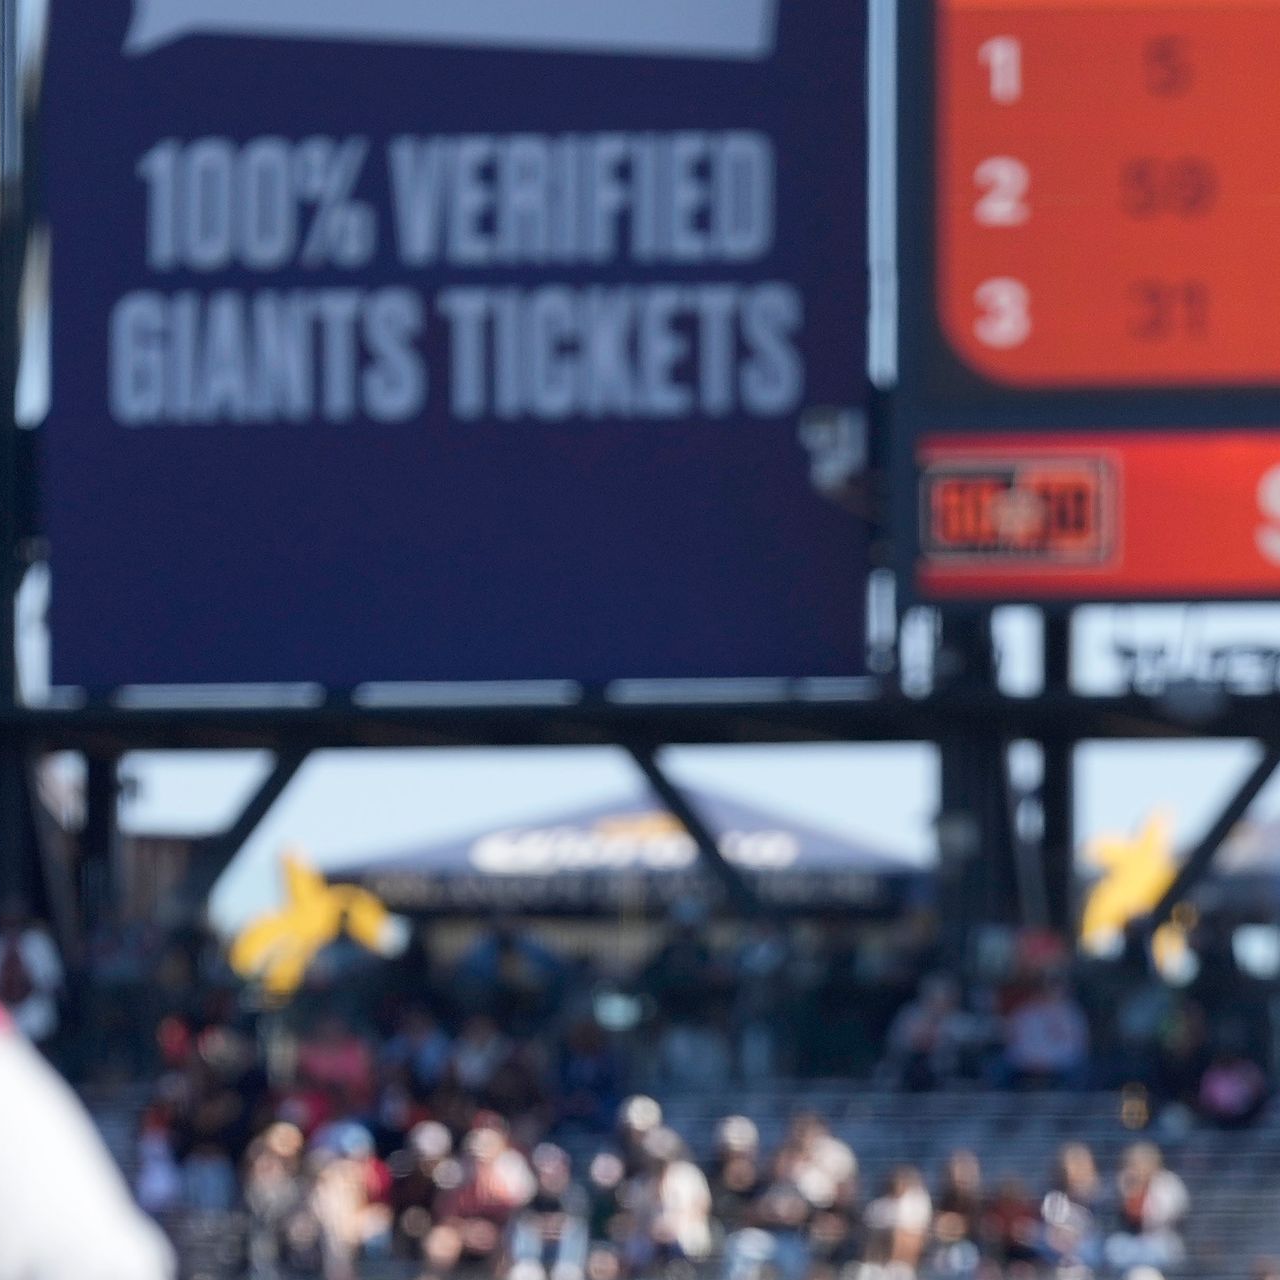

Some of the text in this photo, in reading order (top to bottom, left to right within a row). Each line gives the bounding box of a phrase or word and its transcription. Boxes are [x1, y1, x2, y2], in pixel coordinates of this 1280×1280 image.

[977, 35, 1023, 104] 1
[1141, 34, 1197, 100] 5
[136, 130, 776, 272] 100% VERIFIED
[973, 155, 1030, 227] 2
[973, 276, 1032, 348] 3
[111, 280, 803, 426] GIANTS TICKETS
